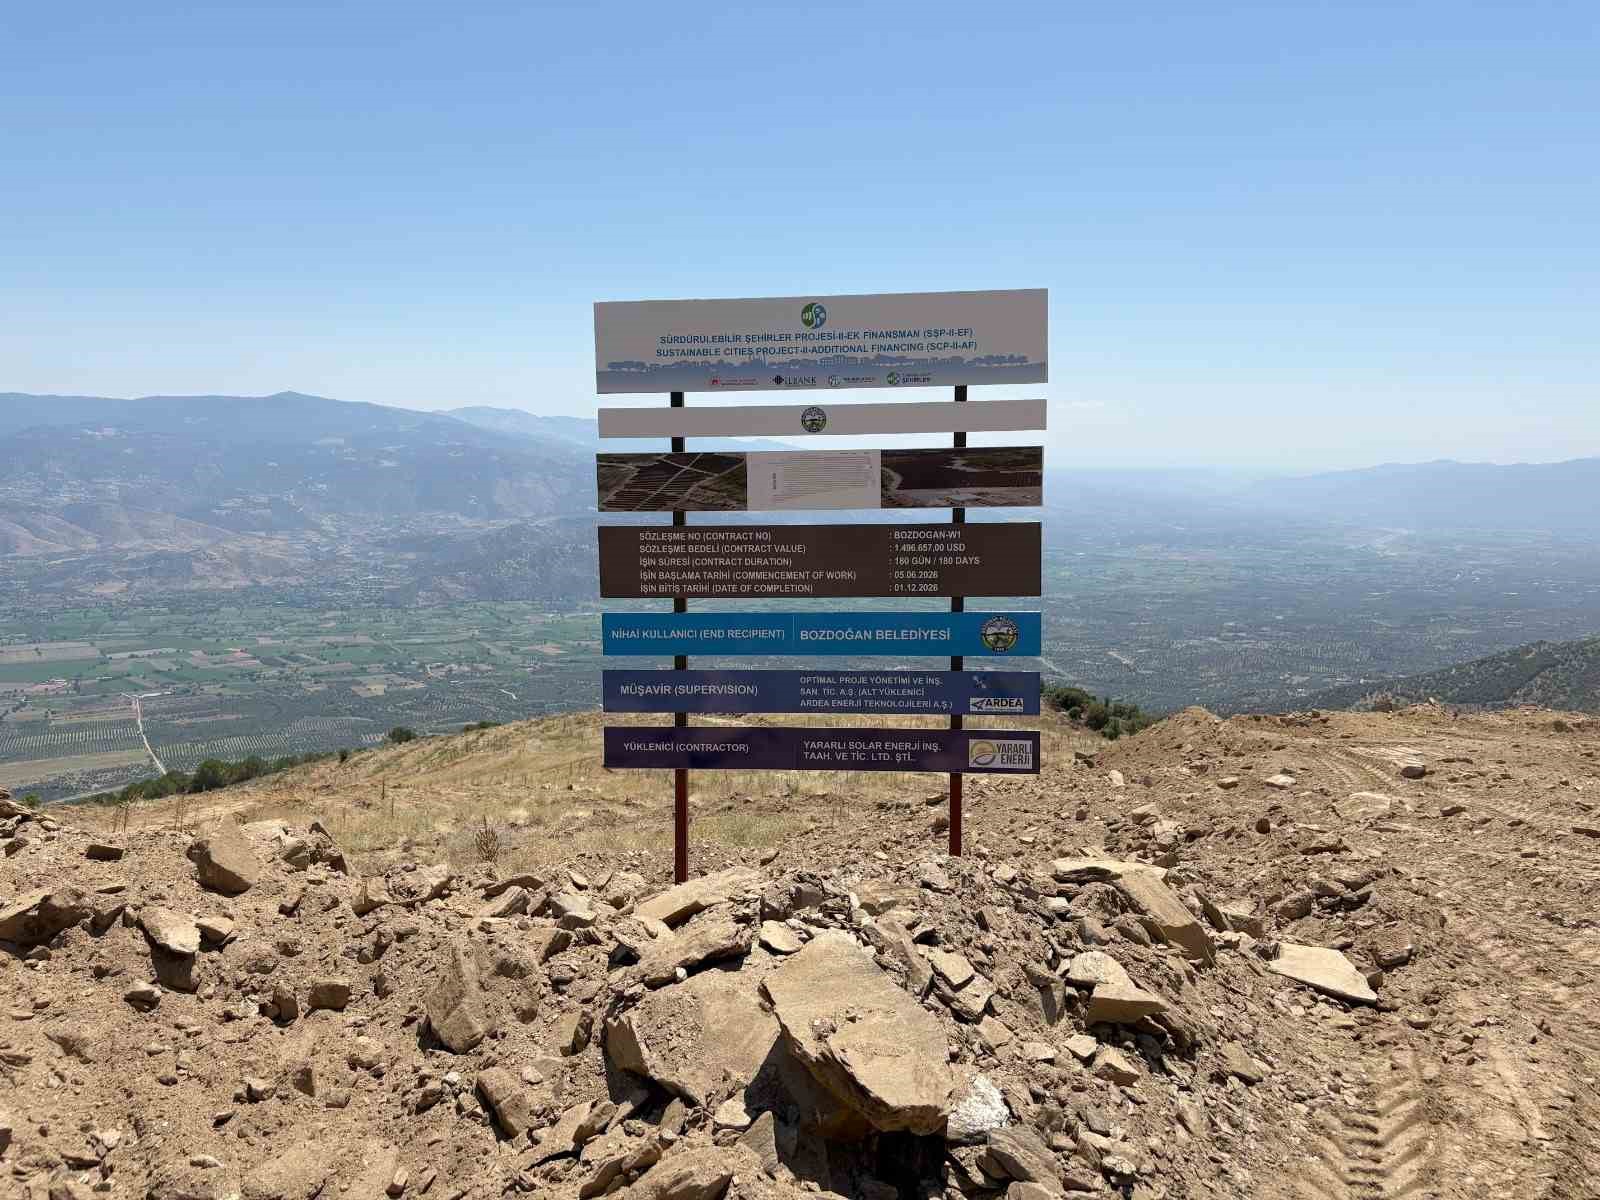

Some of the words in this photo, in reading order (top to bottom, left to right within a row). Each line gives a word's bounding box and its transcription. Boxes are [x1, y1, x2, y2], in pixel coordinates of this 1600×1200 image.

[656, 348, 721, 357] SUSTAINABLE
[723, 348, 753, 356] CITIES
[871, 342, 924, 352] FINANCING
[926, 341, 977, 352] (SCP-II-AF)
[688, 532, 700, 541] NO
[702, 532, 753, 542] (CONTRACT
[755, 532, 772, 541] NO)
[688, 543, 720, 553] BEDELİ
[722, 544, 773, 554] (CONTRACT
[774, 544, 806, 554] VALUE)
[946, 544, 966, 552] USD
[692, 557, 742, 567] (CONTRACT
[744, 557, 792, 567] DURATION)
[939, 556, 954, 565] 180
[956, 556, 980, 565] DAYS
[732, 570, 810, 580] (COMMENCEMENT
[812, 570, 825, 580] OF
[826, 570, 857, 580] WORK)
[712, 584, 738, 594] (DATE
[740, 584, 752, 592] OF
[754, 584, 813, 594] COMPLETION)
[612, 629, 640, 640] NİHAİ
[642, 630, 698, 640] KULLANICI
[700, 629, 725, 640] (END
[728, 629, 785, 640] RECIPIENT)
[876, 627, 950, 640] BELEDİYESİ
[840, 676, 868, 684] PROJE
[912, 676, 924, 685] VE
[620, 683, 672, 696] MÜŞAVİR
[674, 684, 758, 696] (SUPERVISION)
[800, 700, 830, 708] ARDEA
[985, 698, 1024, 708] ARDEA
[624, 742, 674, 752] YÜKLENİCİ
[676, 742, 750, 754] (CONTRACTOR)
[804, 741, 846, 750] YARARLI
[849, 742, 882, 750] SOLAR
[884, 740, 920, 751] ENERJİ
[994, 742, 1032, 754] YARARLI
[804, 752, 832, 762] TAAH.
[834, 752, 848, 762] VE
[850, 750, 870, 762] TİC.
[872, 752, 894, 762] LTD.
